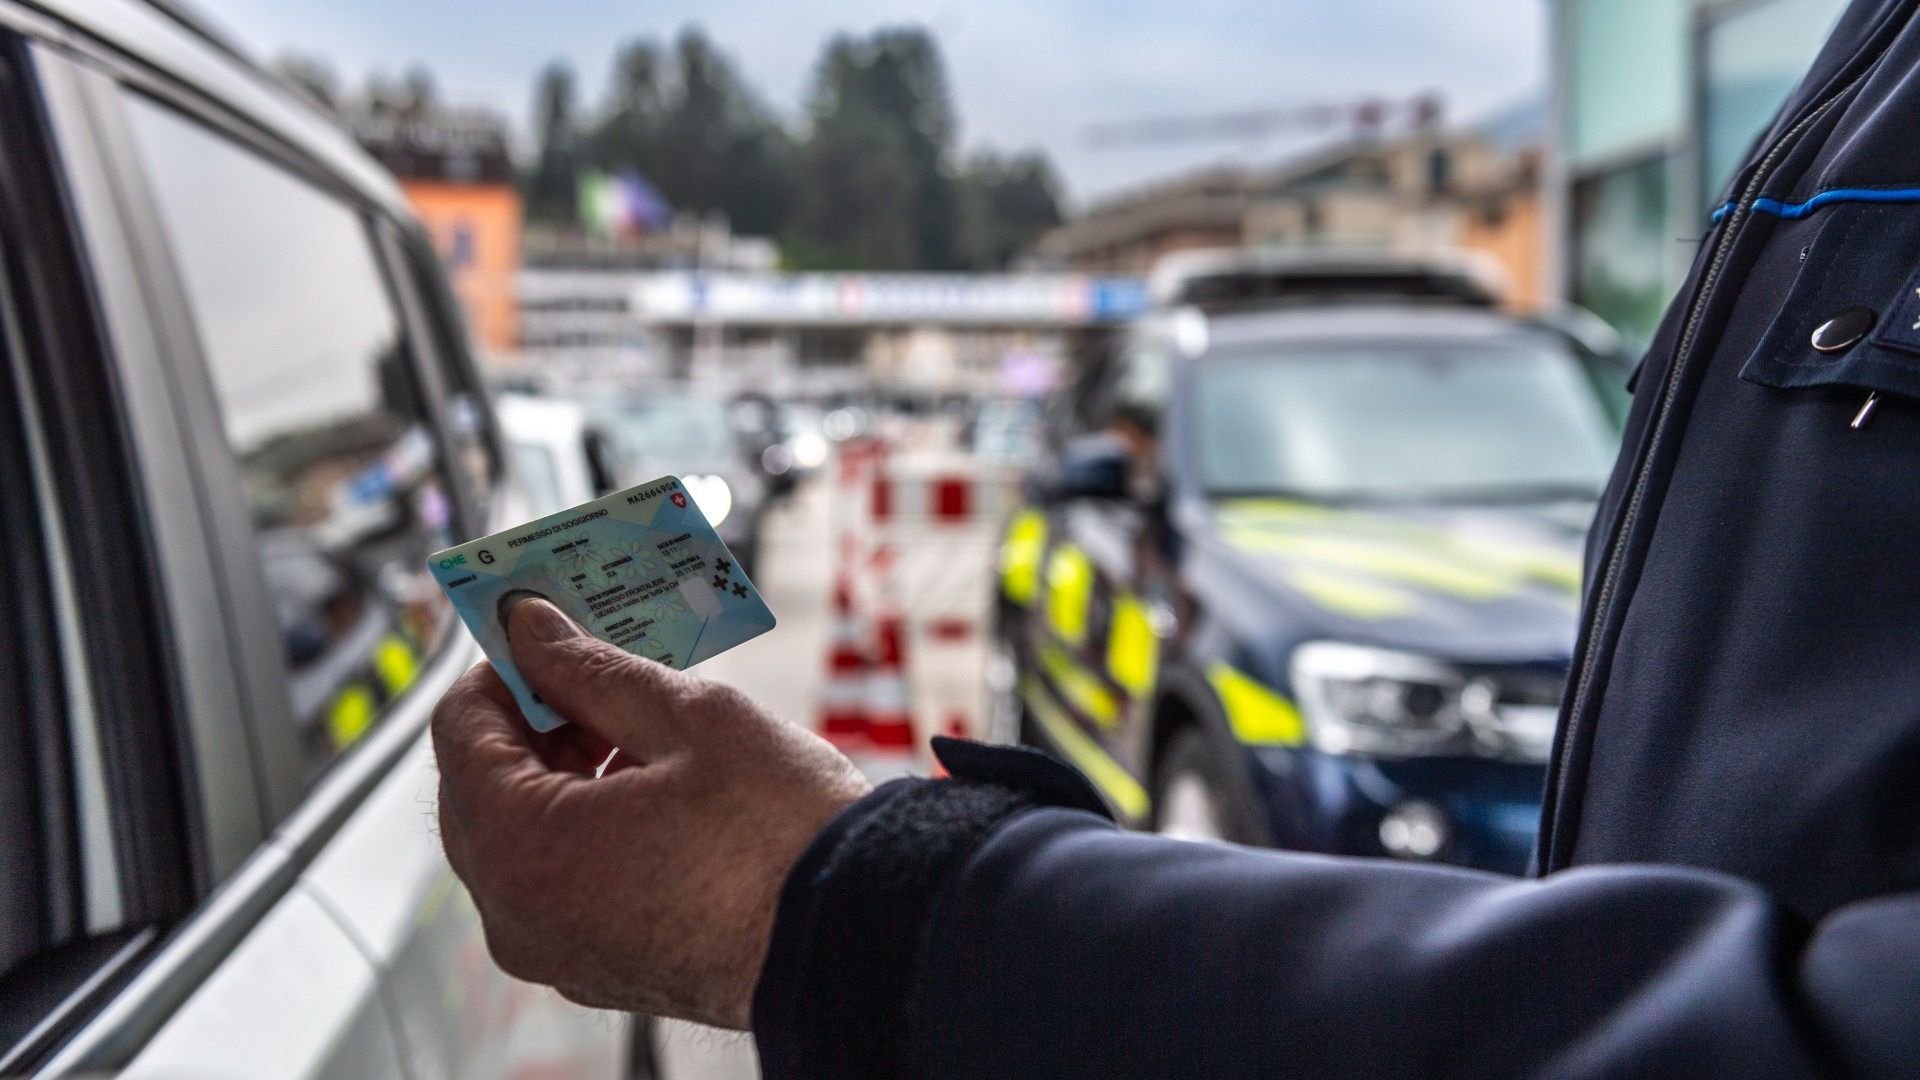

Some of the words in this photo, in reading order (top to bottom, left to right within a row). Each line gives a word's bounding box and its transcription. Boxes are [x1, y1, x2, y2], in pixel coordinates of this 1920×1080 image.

[508, 528, 552, 549] PERMESSO
[553, 524, 563, 534] DI
[563, 508, 608, 530] SOGGIORNO
[674, 533, 692, 545] NASCITA
[439, 554, 467, 570] CHE
[478, 550, 496, 564] G
[601, 555, 633, 571] CITTADINANZA
[571, 573, 587, 583] SESSO
[605, 571, 618, 579] ITA
[585, 595, 597, 604] TIPO
[602, 584, 626, 598] PERMESSO
[590, 593, 625, 611] PERMESSO
[625, 577, 666, 597] FRONTALIERE
[595, 603, 623, 619] UE/AELS
[623, 597, 640, 608] valido
[640, 593, 650, 602] per
[651, 587, 663, 596] tutta
[663, 584, 670, 592] la
[669, 580, 679, 589] CH
[630, 618, 655, 631] lucrativa
